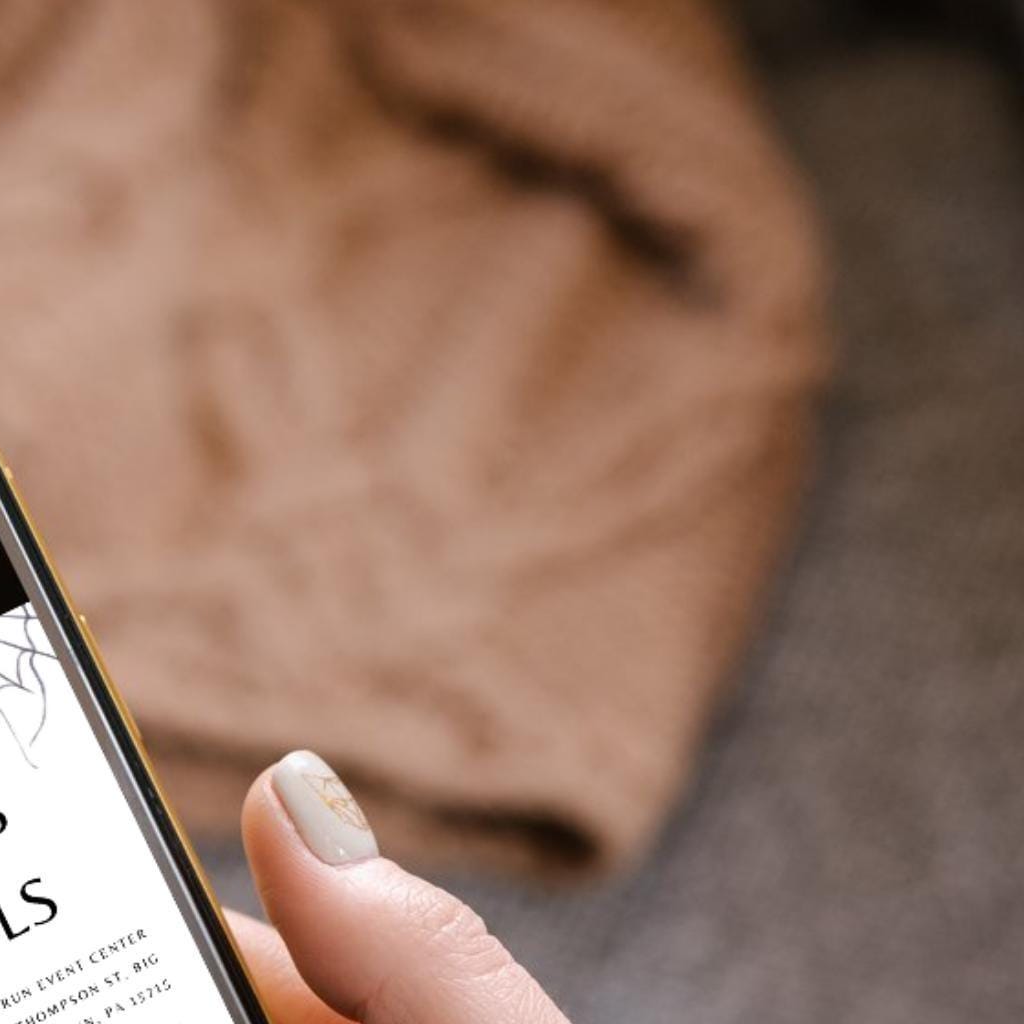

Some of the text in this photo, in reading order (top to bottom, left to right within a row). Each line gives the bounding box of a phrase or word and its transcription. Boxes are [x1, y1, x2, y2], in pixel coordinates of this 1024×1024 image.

[0, 988, 33, 1010] RUN
[36, 960, 84, 992] EVENT
[88, 929, 148, 964] CENTER
[132, 953, 159, 974] BIG
[103, 1003, 126, 1019] PA
